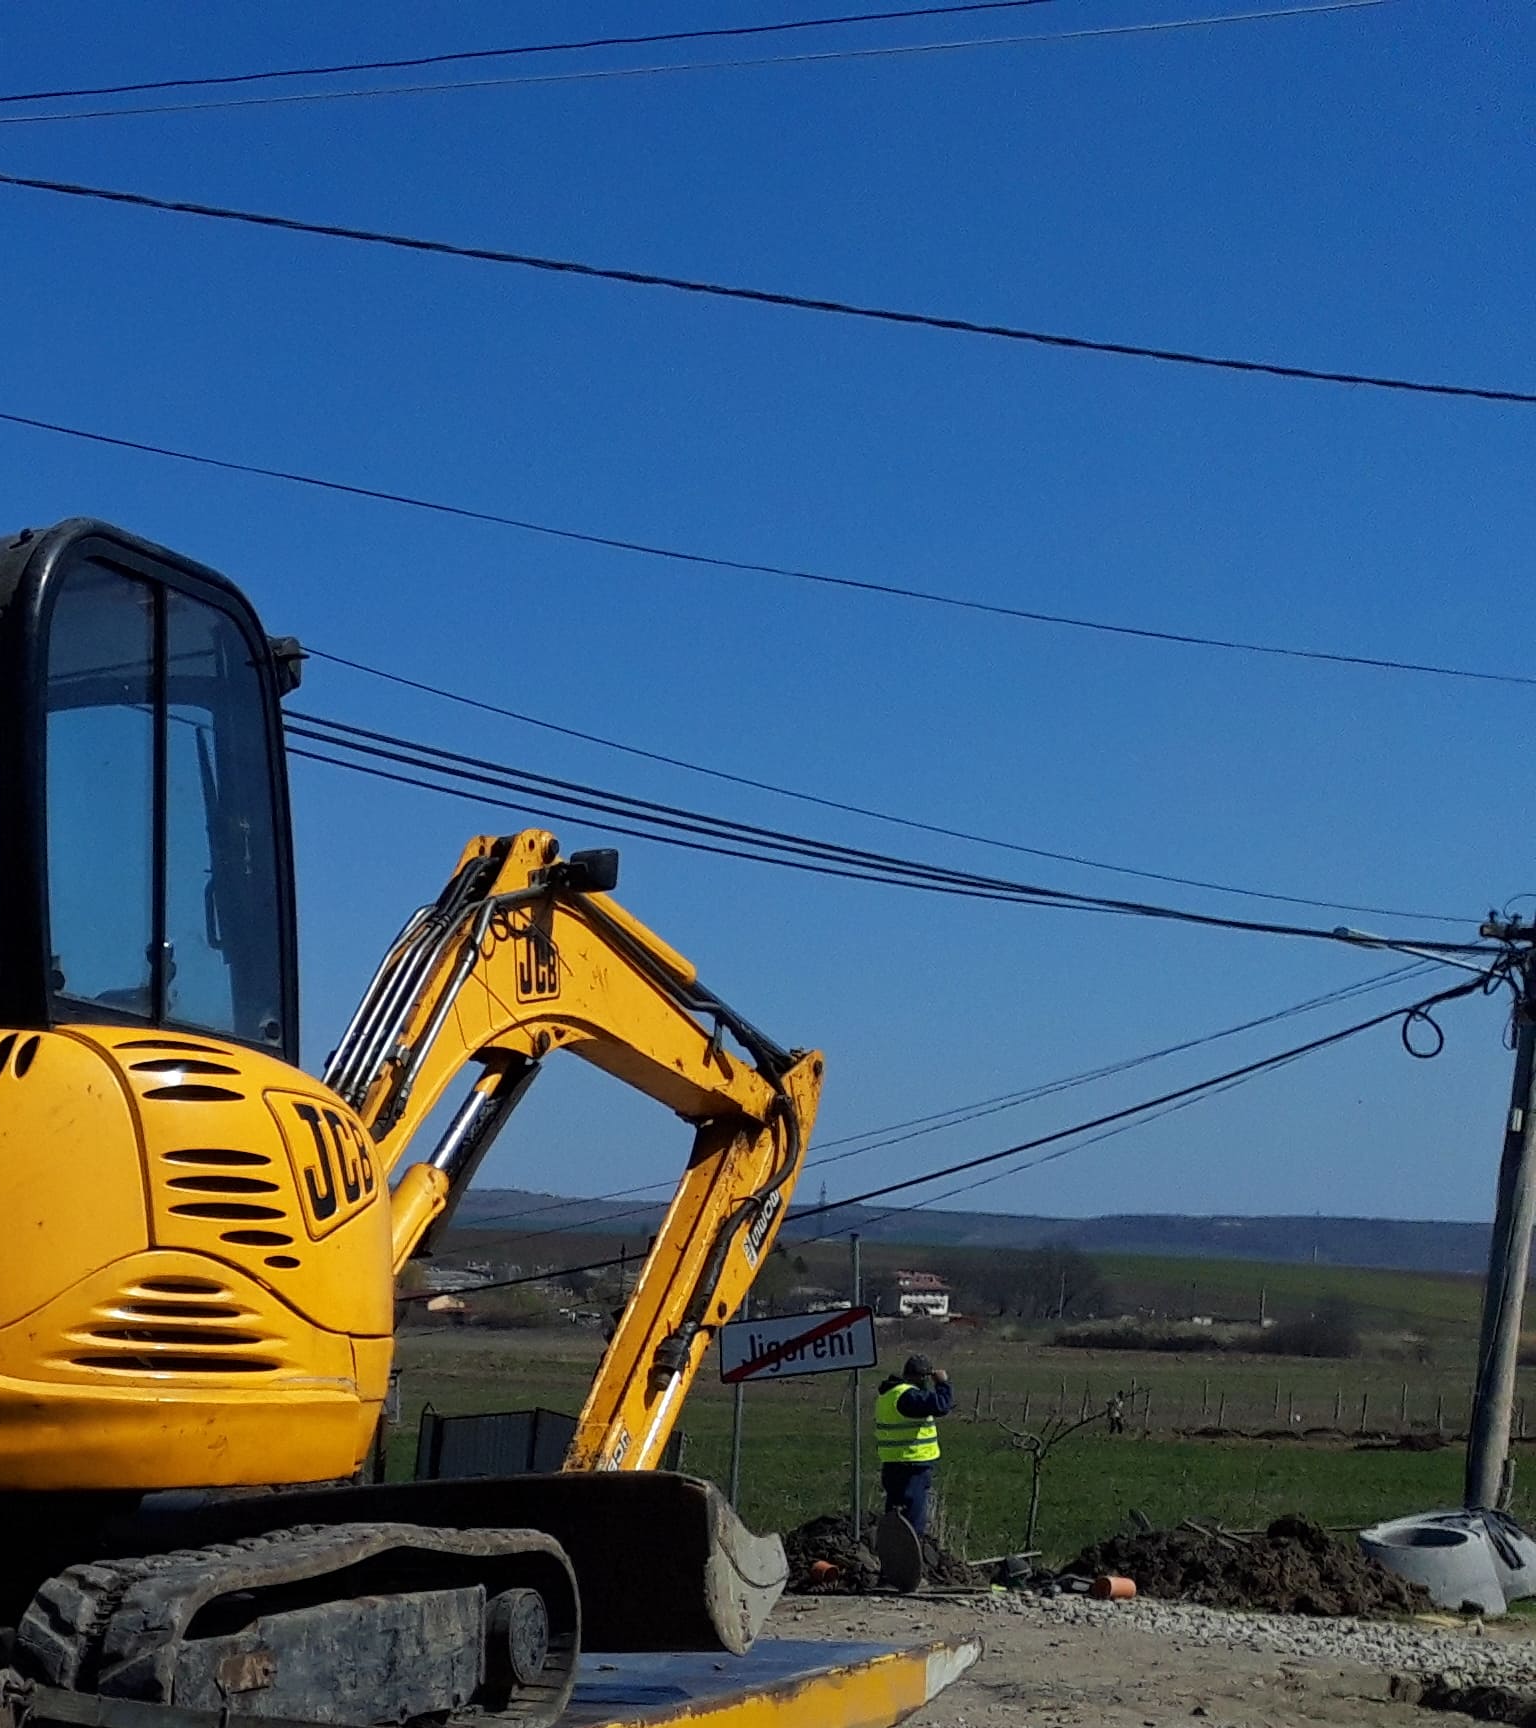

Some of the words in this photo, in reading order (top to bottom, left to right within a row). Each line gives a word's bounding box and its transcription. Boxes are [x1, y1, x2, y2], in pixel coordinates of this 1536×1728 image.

[518, 930, 558, 995] JCB
[292, 1102, 375, 1222] JCB
[740, 1324, 855, 1373] Jigoreni
